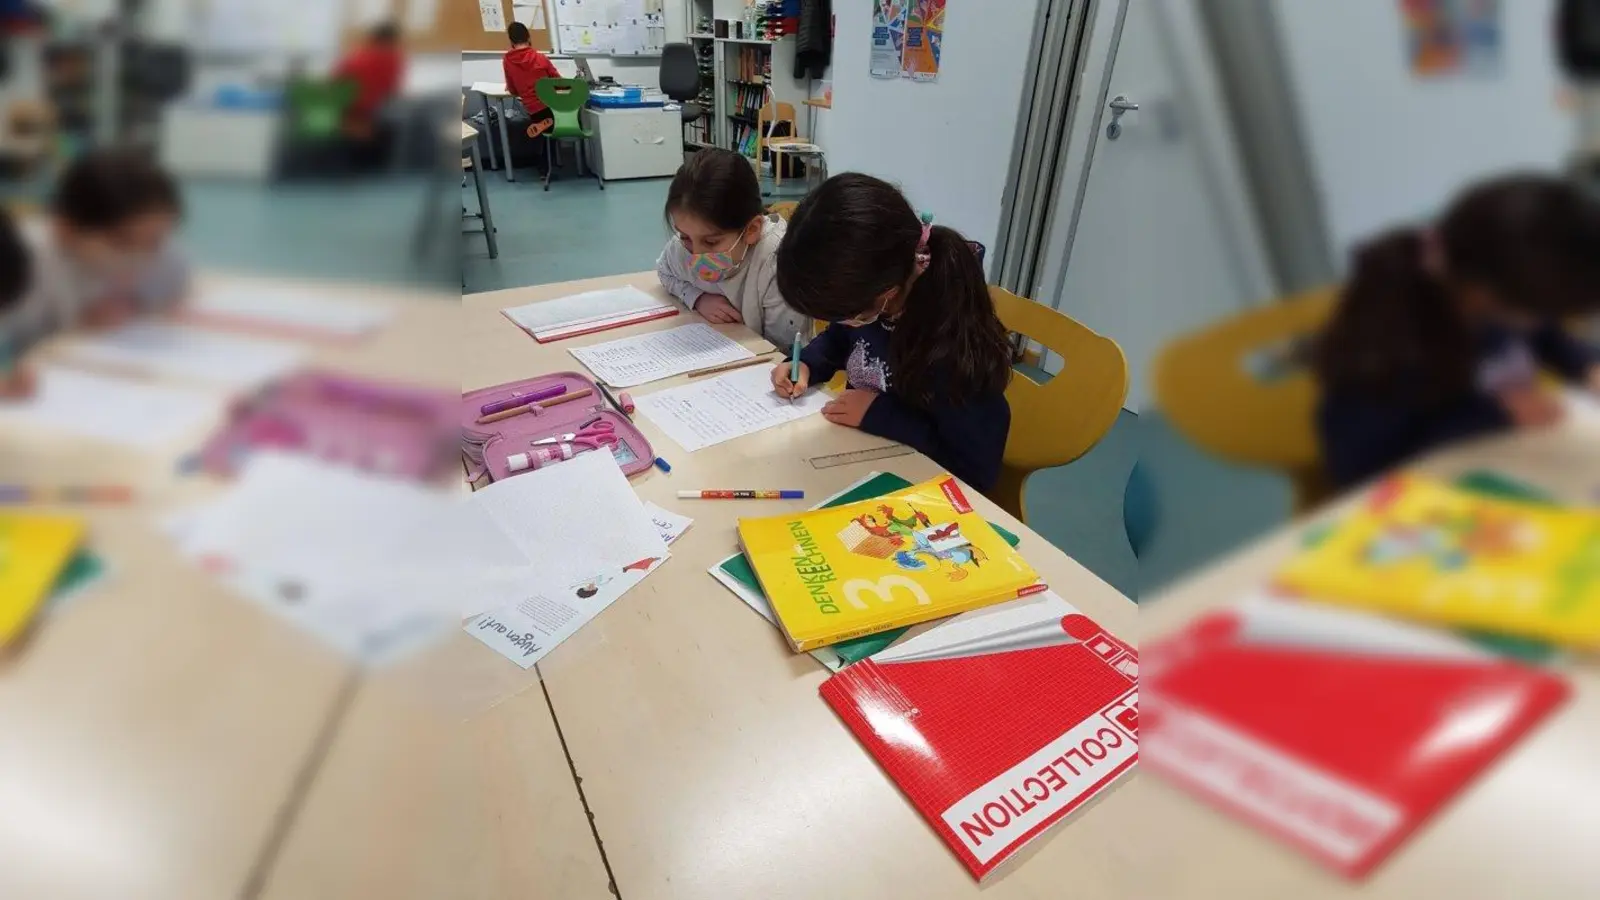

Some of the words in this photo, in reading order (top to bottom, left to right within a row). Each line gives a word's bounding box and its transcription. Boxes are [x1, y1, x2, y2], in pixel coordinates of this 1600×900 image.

[786, 520, 837, 583] RECHNEN
[791, 556, 841, 615] DENKEN
[842, 574, 932, 610] 3
[478, 616, 507, 633] auf!
[506, 630, 542, 657] Augen
[959, 727, 1122, 847] COLLECTION
